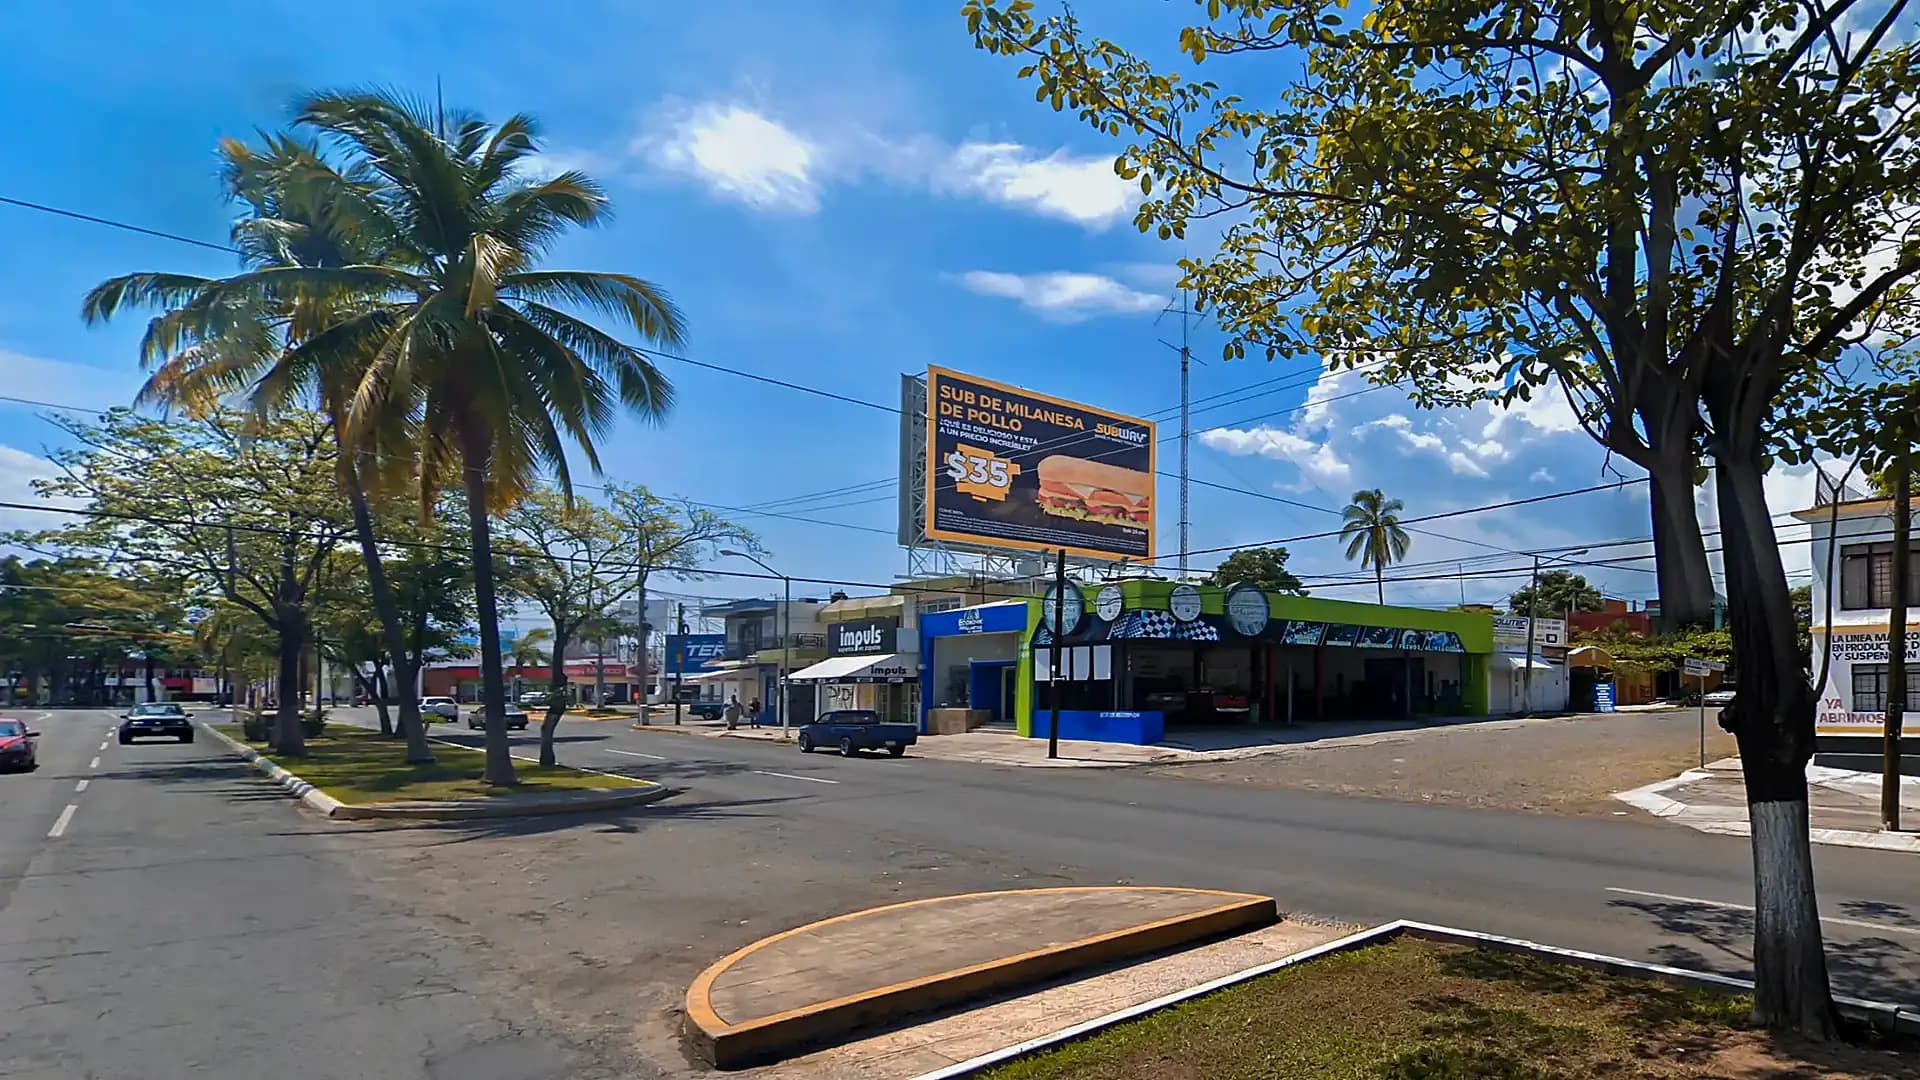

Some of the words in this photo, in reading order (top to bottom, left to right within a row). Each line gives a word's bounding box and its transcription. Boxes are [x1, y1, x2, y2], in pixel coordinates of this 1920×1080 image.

[940, 384, 975, 404] SUB
[979, 394, 1002, 412] DE
[1006, 400, 1085, 430] MILANESA
[940, 401, 964, 419] DE
[967, 408, 1023, 432] POLLO
[946, 428, 959, 437] UN
[959, 431, 989, 443] PRECIO
[972, 425, 1013, 440] DELICIOSO
[1095, 422, 1147, 443] SUBWAY
[946, 451, 1009, 487] $35
[840, 624, 881, 651] impuls
[1832, 634, 1844, 643] LA
[1845, 633, 1873, 642] LINEA
[1832, 643, 1844, 652] EN
[1833, 653, 1842, 661] Y
[870, 664, 907, 676] impuls
[1825, 698, 1842, 709] YA
[1819, 712, 1886, 724] ABRIMOS
